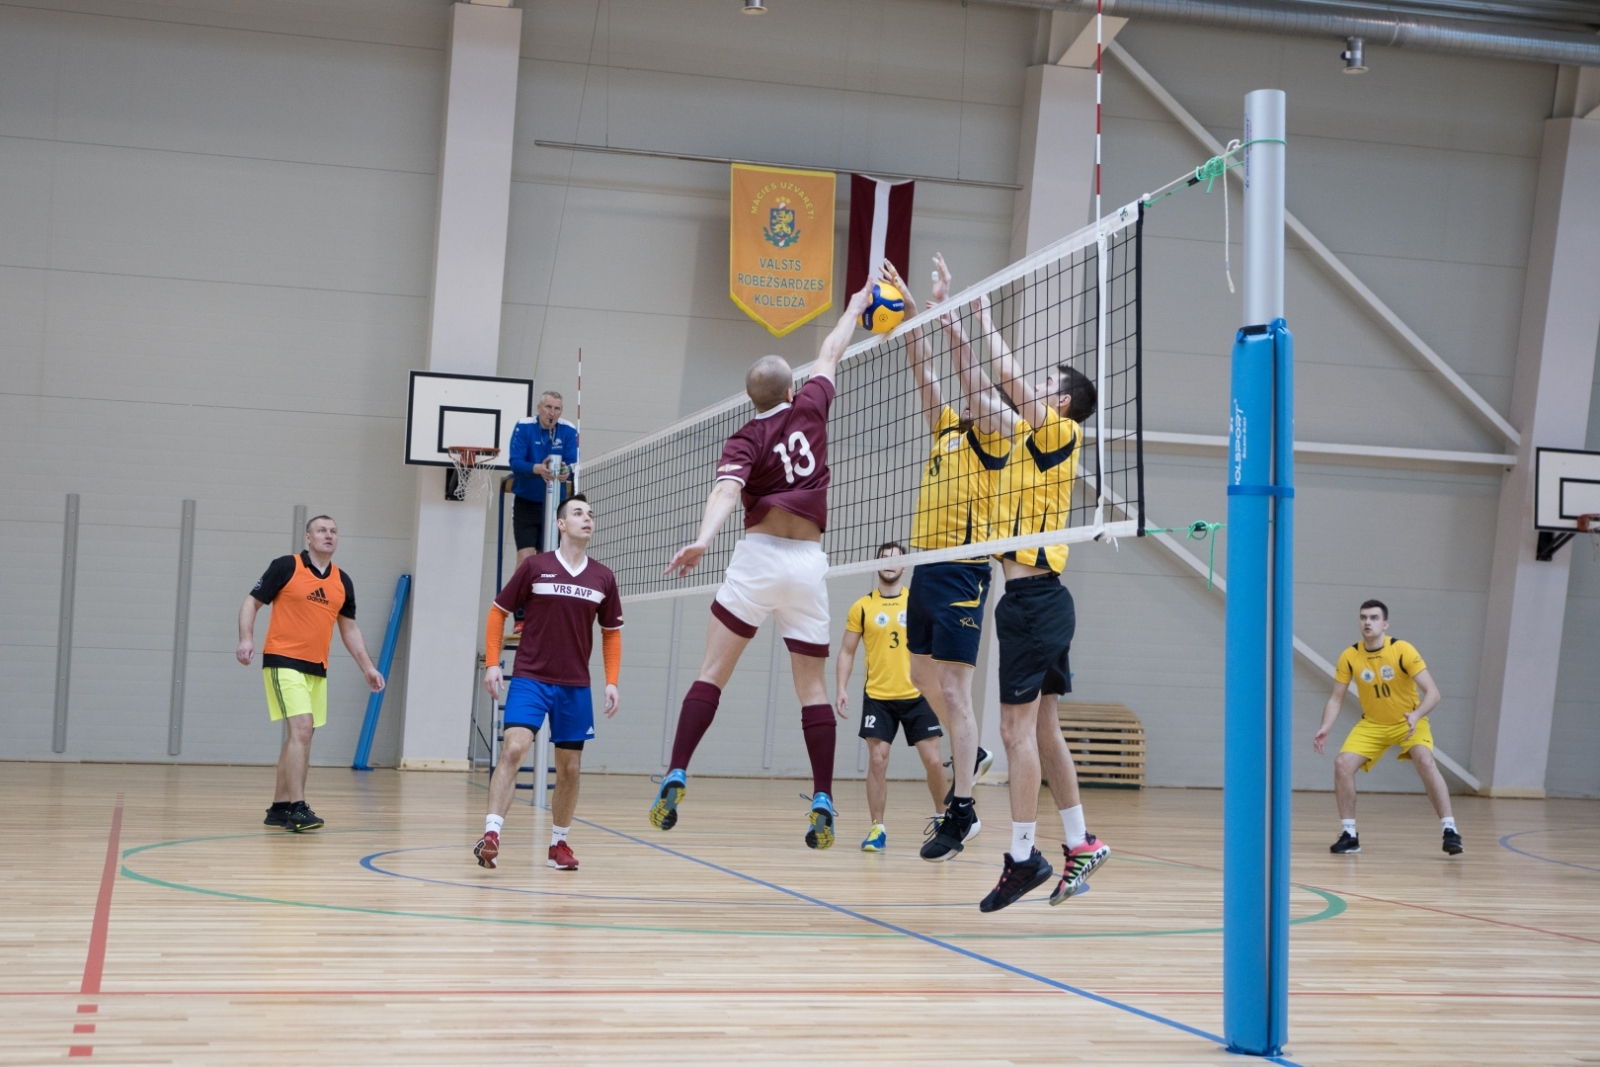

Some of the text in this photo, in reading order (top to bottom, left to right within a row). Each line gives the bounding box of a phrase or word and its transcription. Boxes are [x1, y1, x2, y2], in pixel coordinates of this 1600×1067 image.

[759, 257, 802, 271] VALSTS
[738, 273, 824, 291] ROBEŽSARDZES
[754, 293, 806, 308] KOLEDŽA
[773, 431, 816, 484] 13
[930, 454, 942, 476] 8
[553, 584, 593, 598] VRS AVP
[306, 594, 329, 605] adidas
[889, 631, 899, 648] 3
[1373, 683, 1390, 698] 10
[865, 715, 876, 728] 12
